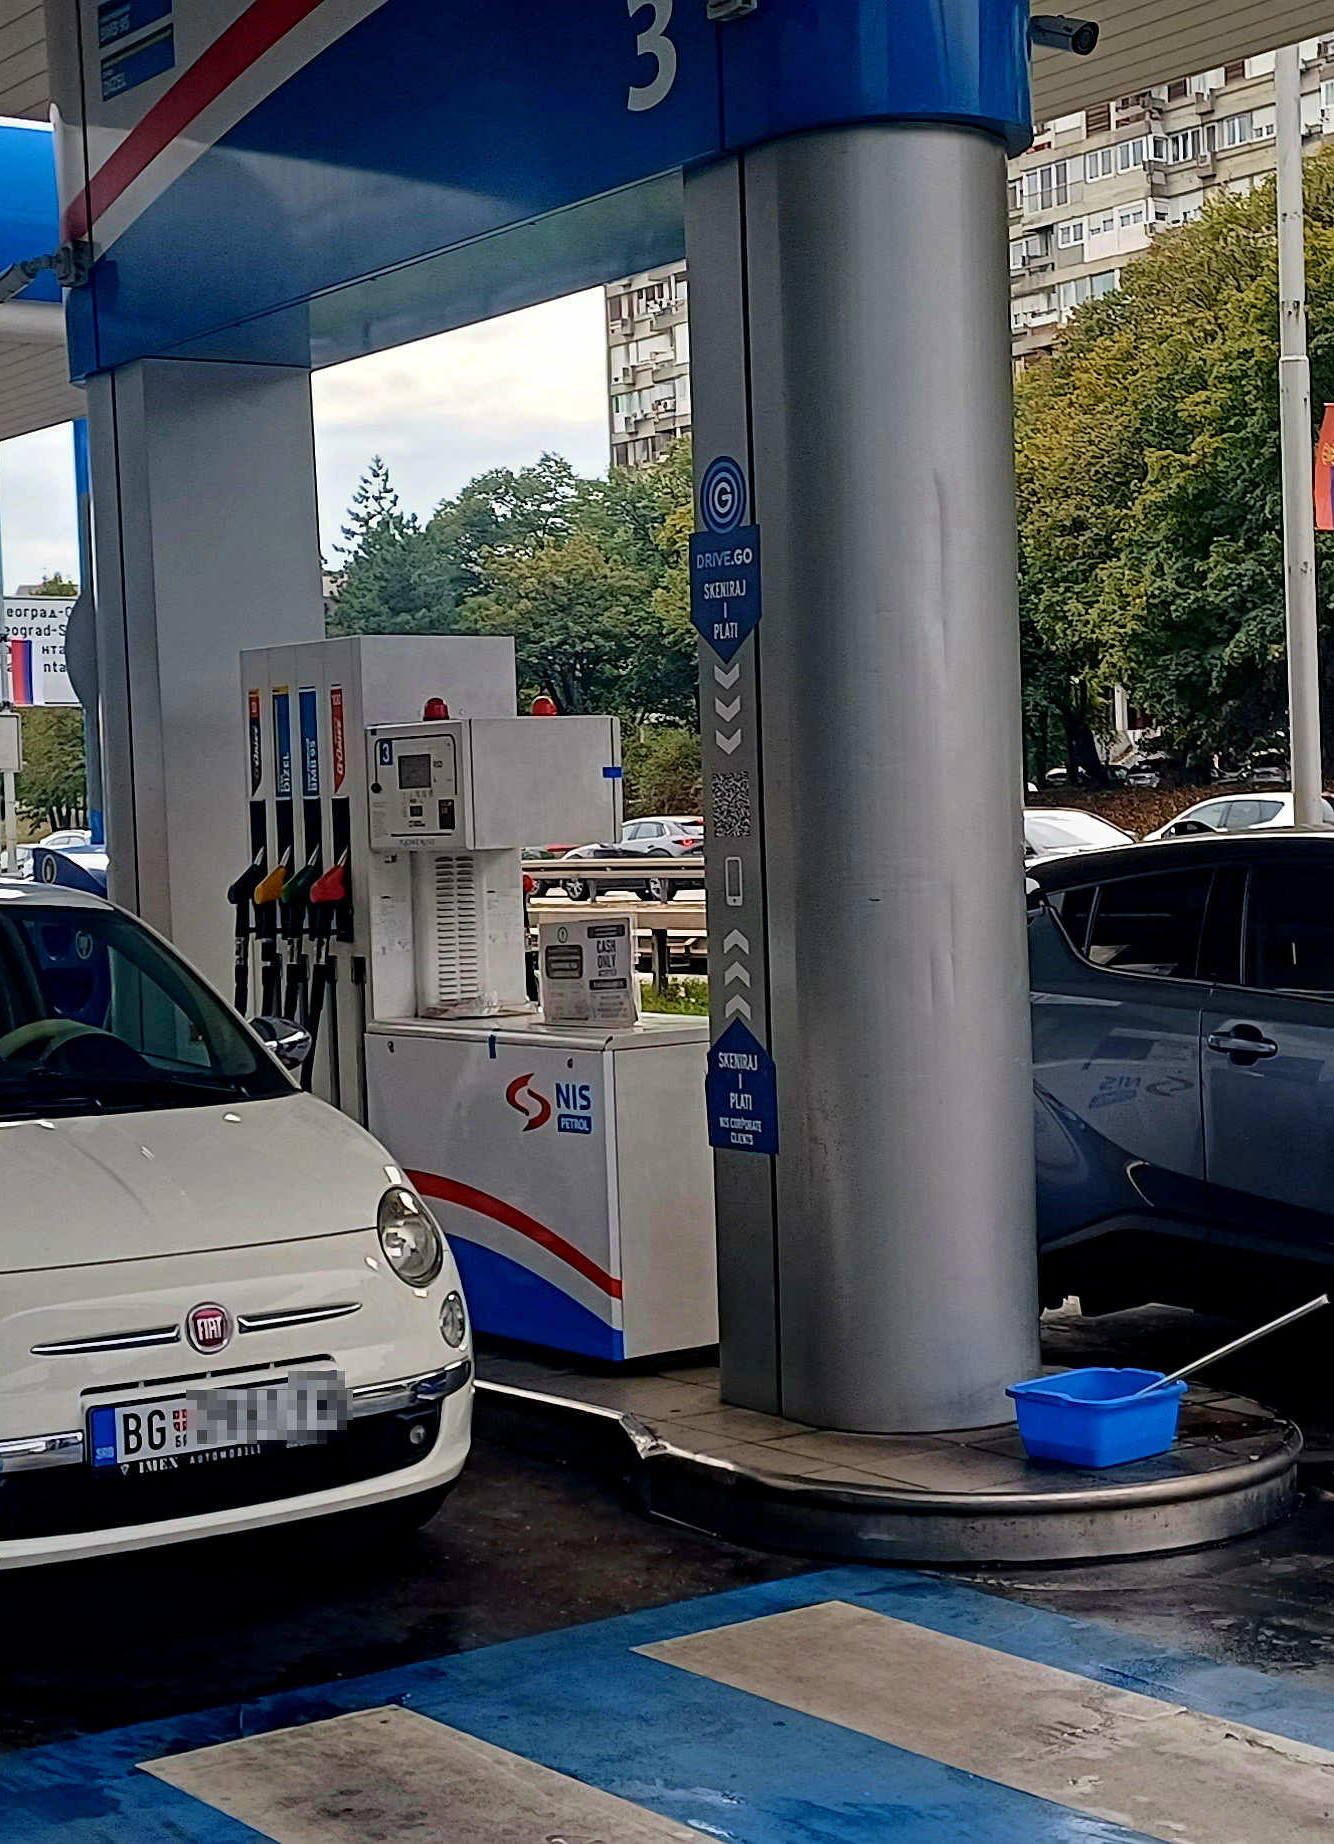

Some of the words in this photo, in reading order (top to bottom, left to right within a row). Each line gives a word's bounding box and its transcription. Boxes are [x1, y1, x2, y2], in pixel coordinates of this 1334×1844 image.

[627, 0, 677, 112] 3
[714, 481, 732, 514] G
[696, 547, 753, 569] DRIVE.GO
[703, 579, 747, 600] SKENIRAJ
[713, 622, 739, 640] PLATI
[382, 742, 390, 763] 3
[718, 1051, 758, 1071] SKENIRAJ
[555, 1082, 592, 1111] NIS
[729, 1092, 753, 1111] PLATI
[560, 1116, 589, 1131] PETROL
[196, 1315, 223, 1341] FIAT
[122, 1409, 166, 1456] BG
[138, 1456, 179, 1474] IMEX
[189, 1443, 262, 1465] AUTOMOBILI
